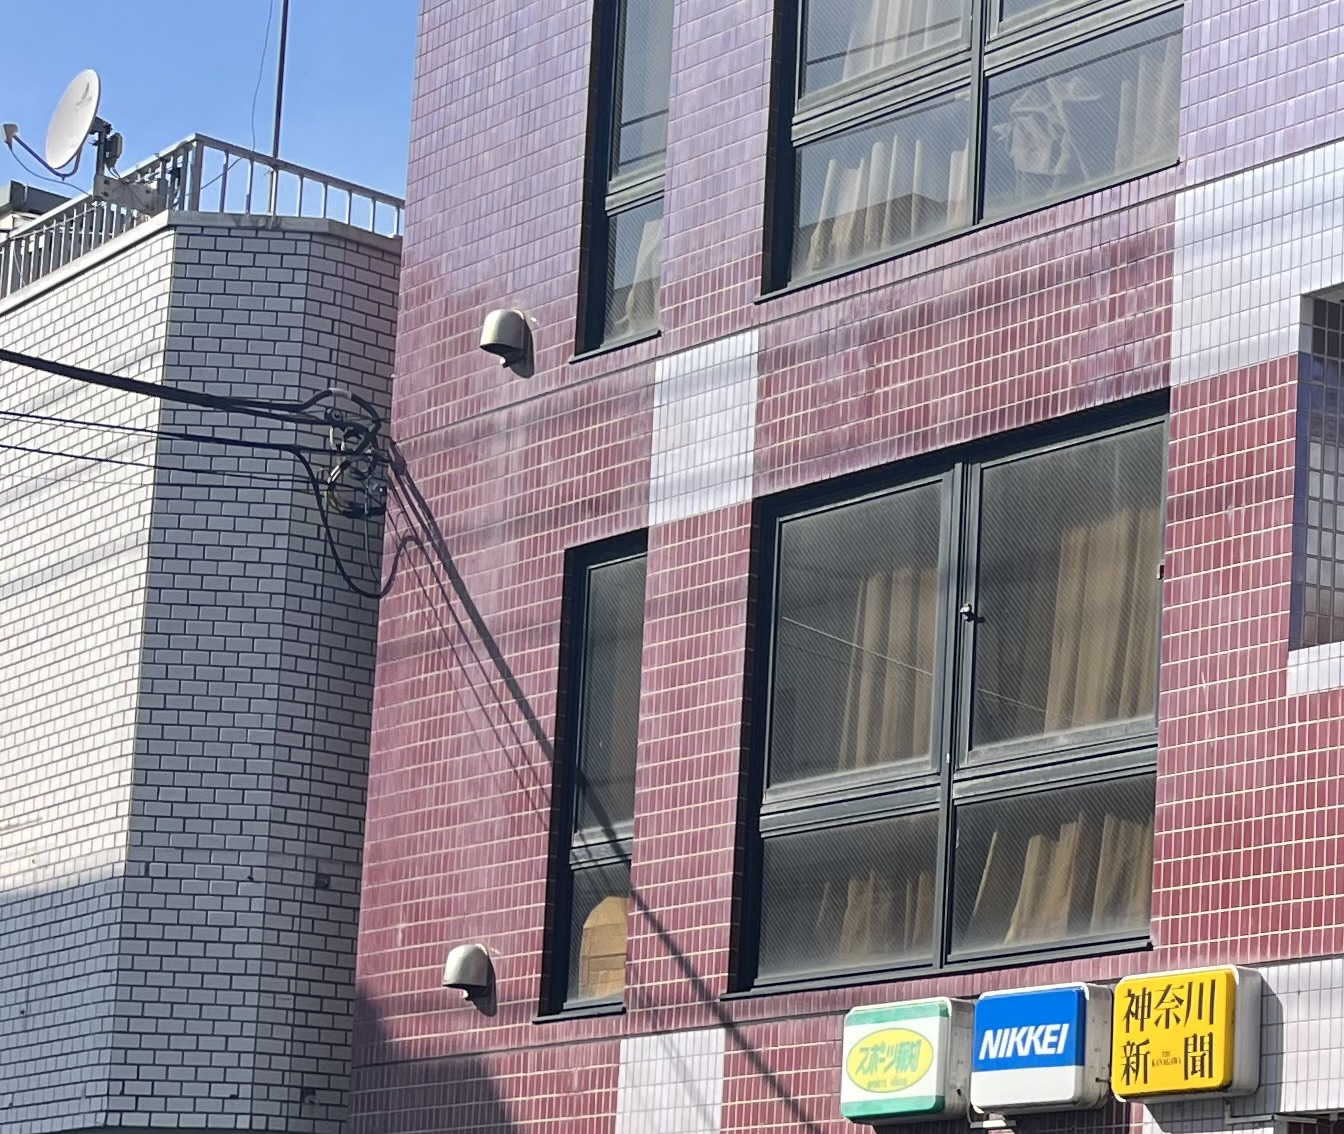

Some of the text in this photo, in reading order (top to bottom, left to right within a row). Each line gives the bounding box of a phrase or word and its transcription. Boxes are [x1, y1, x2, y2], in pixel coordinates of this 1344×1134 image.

[1122, 979, 1216, 1033] 神奈川
[979, 1023, 1070, 1060] NIKKEI
[1120, 1032, 1213, 1086] 新聞
